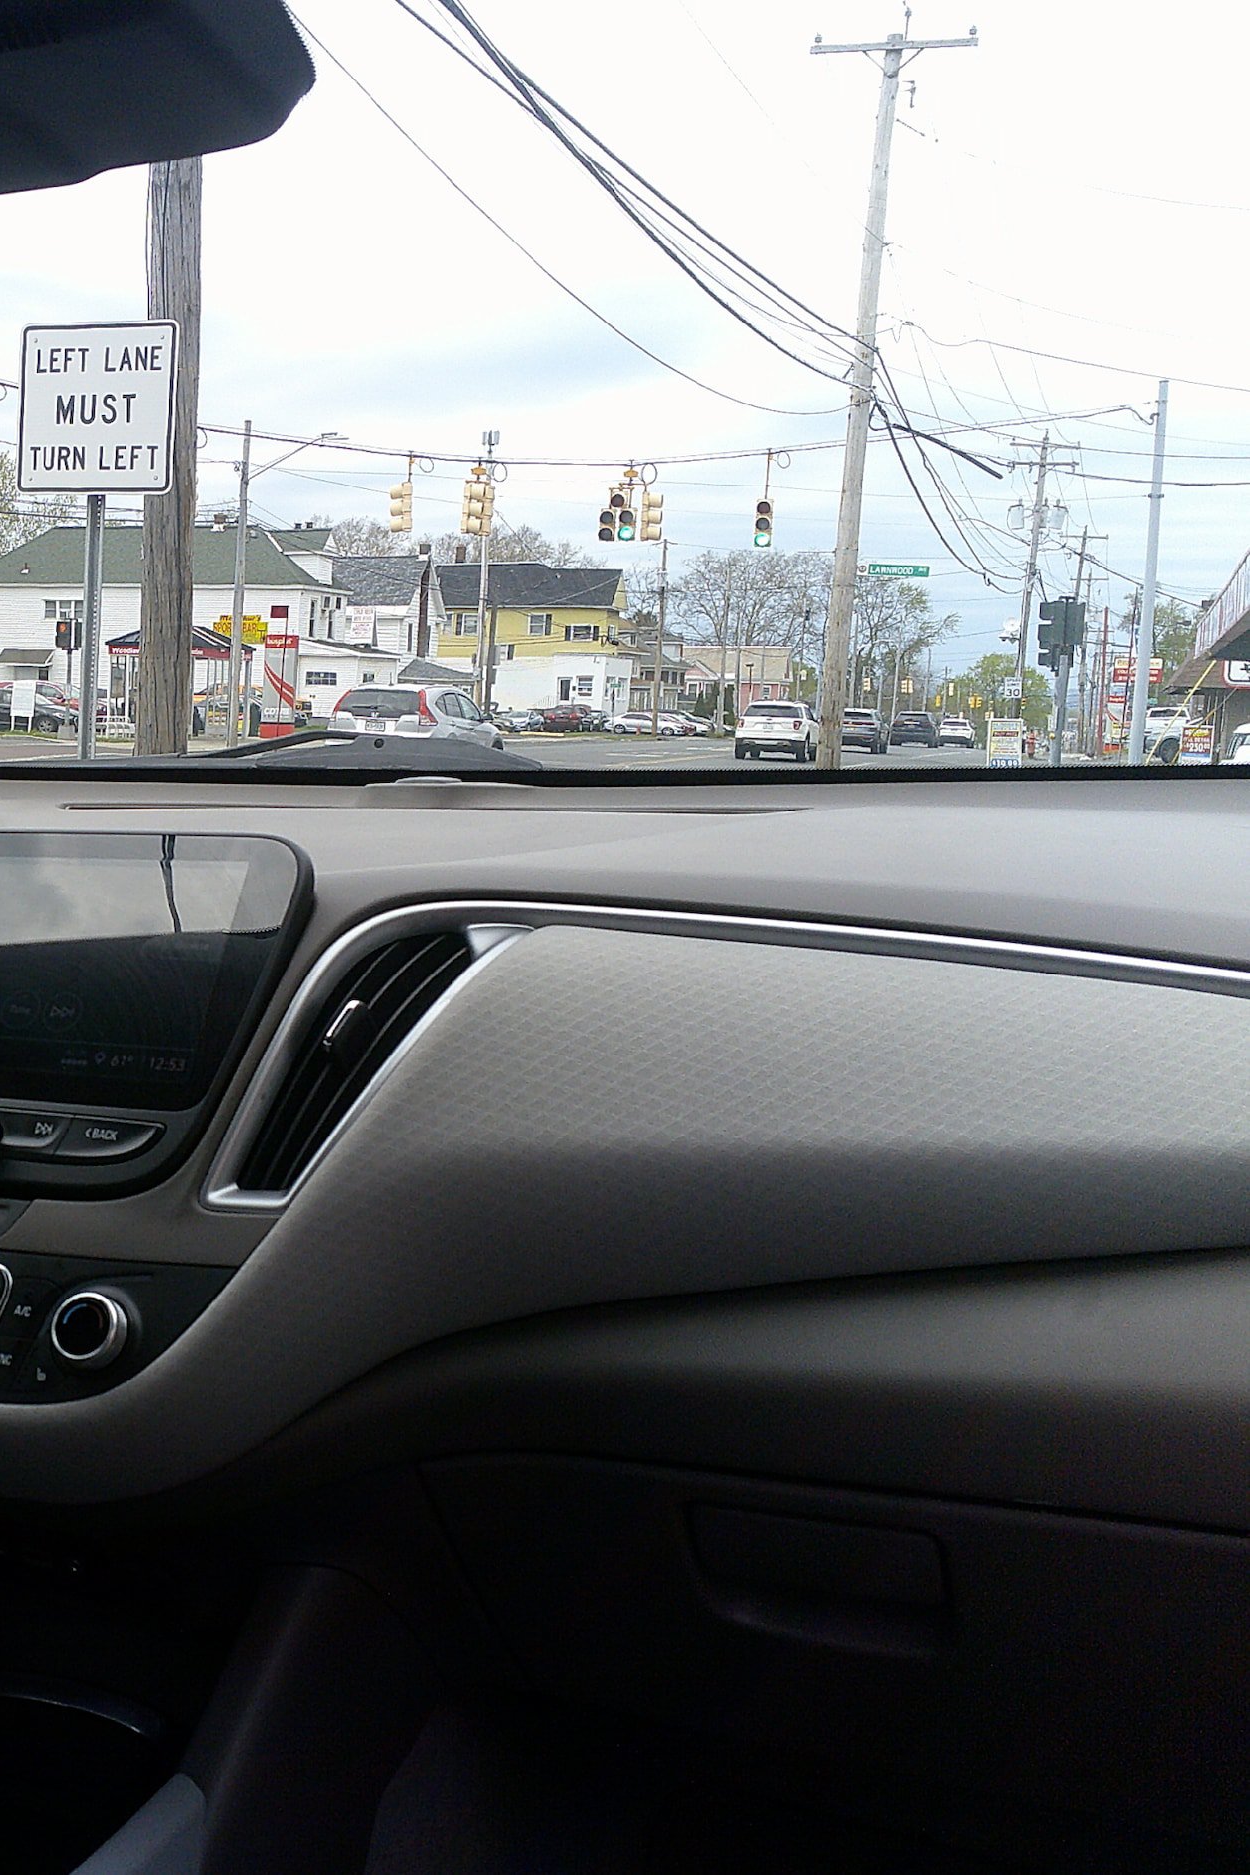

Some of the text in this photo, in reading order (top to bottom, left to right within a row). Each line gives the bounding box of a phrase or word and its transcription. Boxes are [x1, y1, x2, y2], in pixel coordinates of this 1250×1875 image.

[36, 345, 164, 374] LEFT LANE
[55, 393, 137, 425] MUST
[30, 445, 159, 471] TURN LEFT
[870, 566, 914, 575] LAWNWOOD
[1006, 688, 1020, 697] 30
[149, 1058, 186, 1072] 12:53
[91, 1128, 118, 1141] BACK
[13, 1305, 32, 1318] A/C
